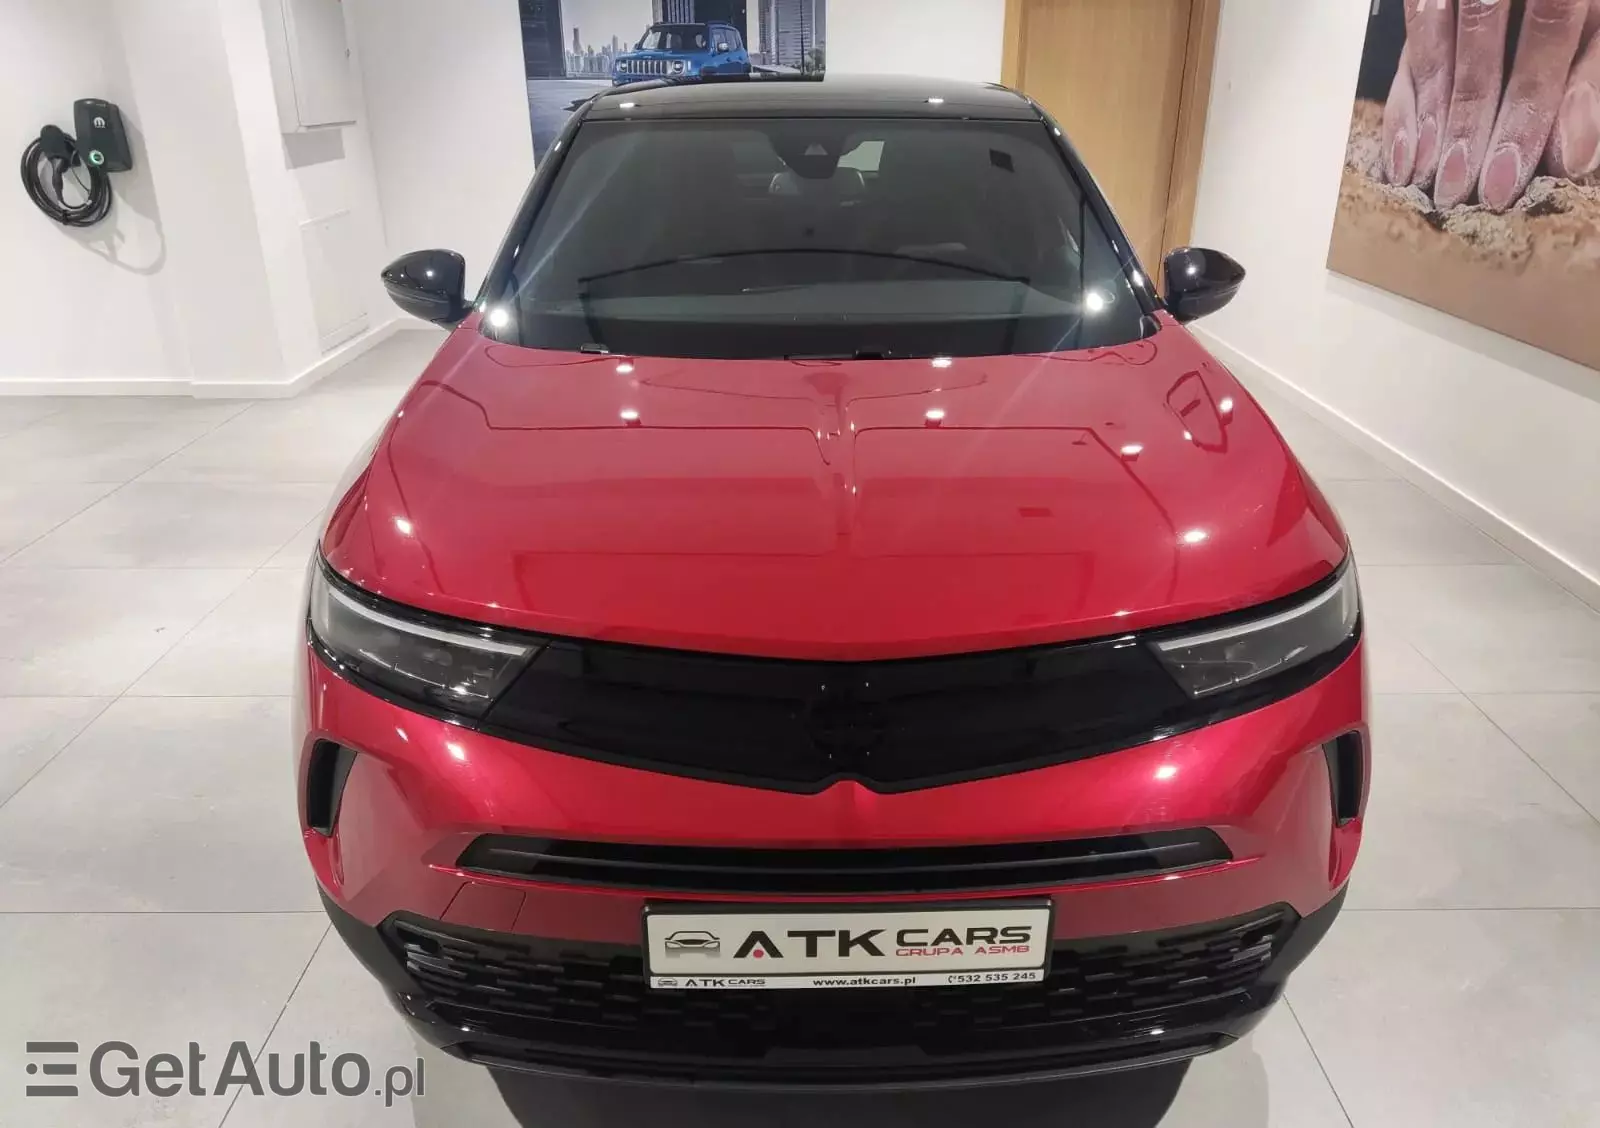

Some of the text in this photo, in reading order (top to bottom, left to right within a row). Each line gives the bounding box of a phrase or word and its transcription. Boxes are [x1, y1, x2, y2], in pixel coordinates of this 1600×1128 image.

[733, 926, 1032, 959] ATK CARS
[895, 945, 1030, 957] GRUPA ASMB
[685, 979, 726, 987] ATK
[813, 976, 916, 986] www.atkcars.pl
[957, 972, 1037, 983] 532 535 245
